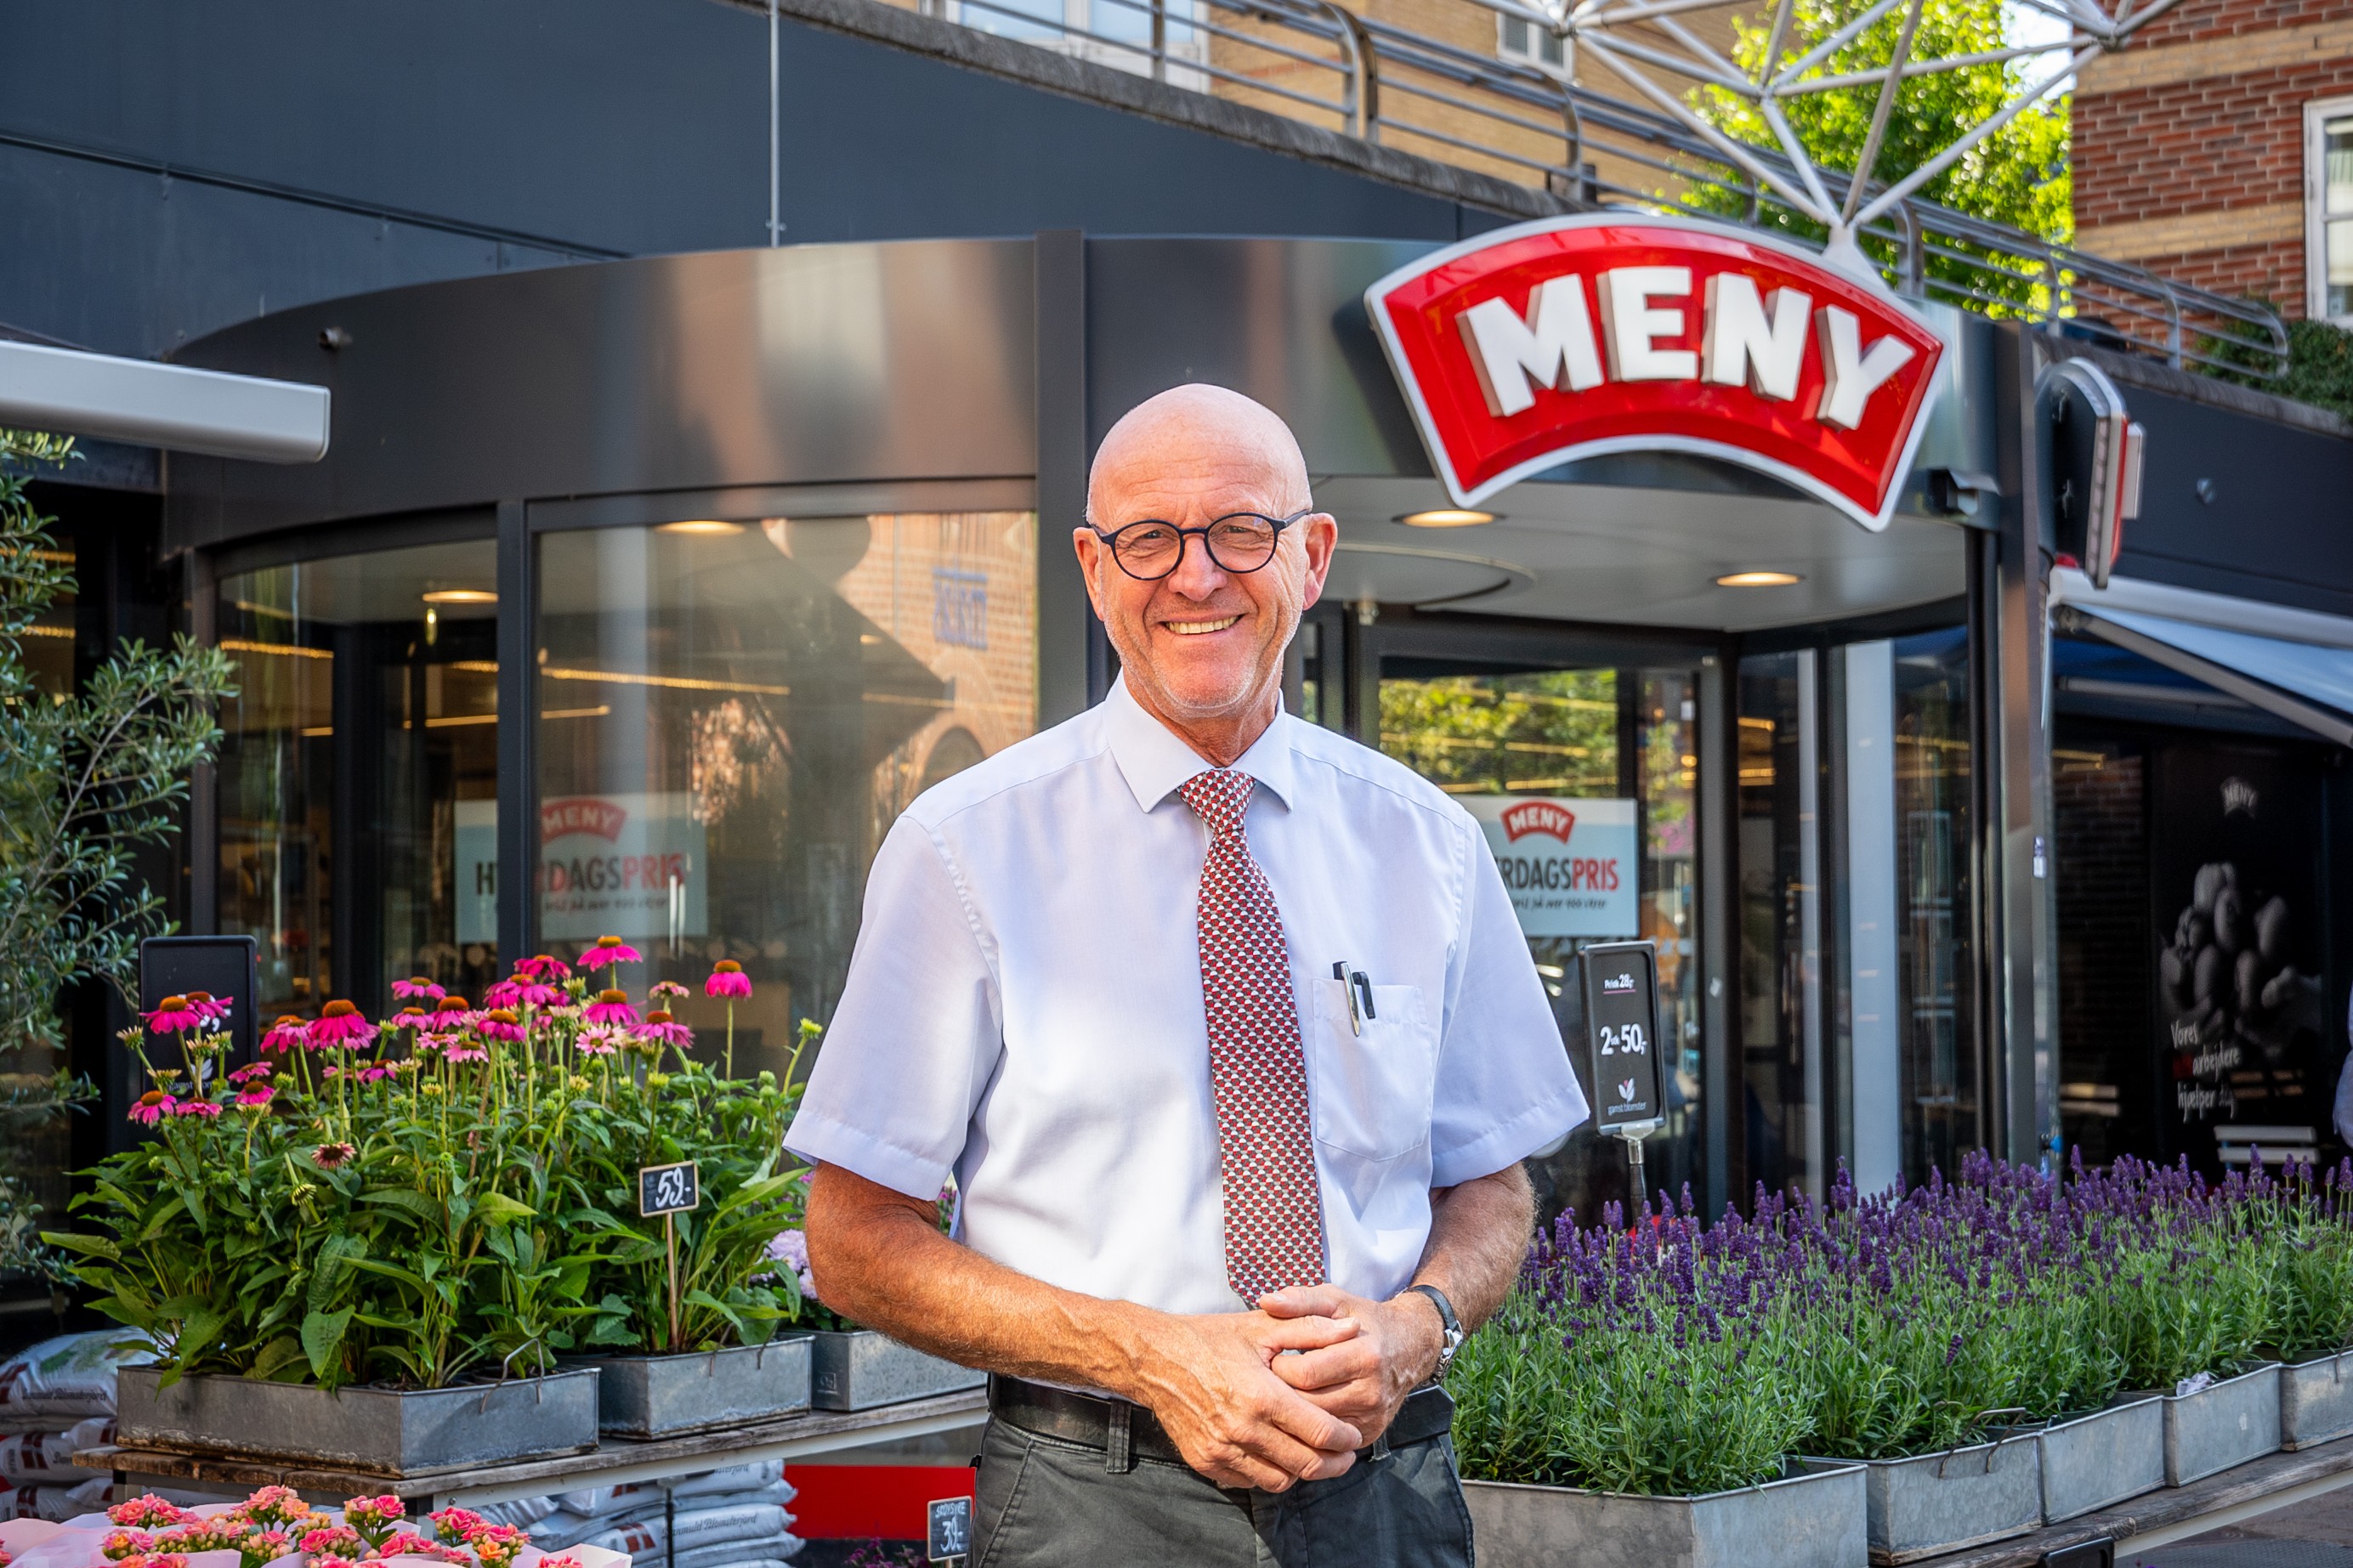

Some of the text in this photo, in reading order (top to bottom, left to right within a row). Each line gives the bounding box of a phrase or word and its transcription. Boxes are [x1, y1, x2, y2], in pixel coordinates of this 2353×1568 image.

[1456, 266, 1915, 430] MENY
[542, 807, 617, 833] MENY
[1508, 807, 1568, 834] MENY
[1494, 857, 1619, 891] RDAGSPRIS
[1600, 1026, 1614, 1055] 2
[2170, 1020, 2199, 1049] Vores
[2177, 1080, 2216, 1124] hjælper
[704, 1514, 757, 1530] Blomsterjord
